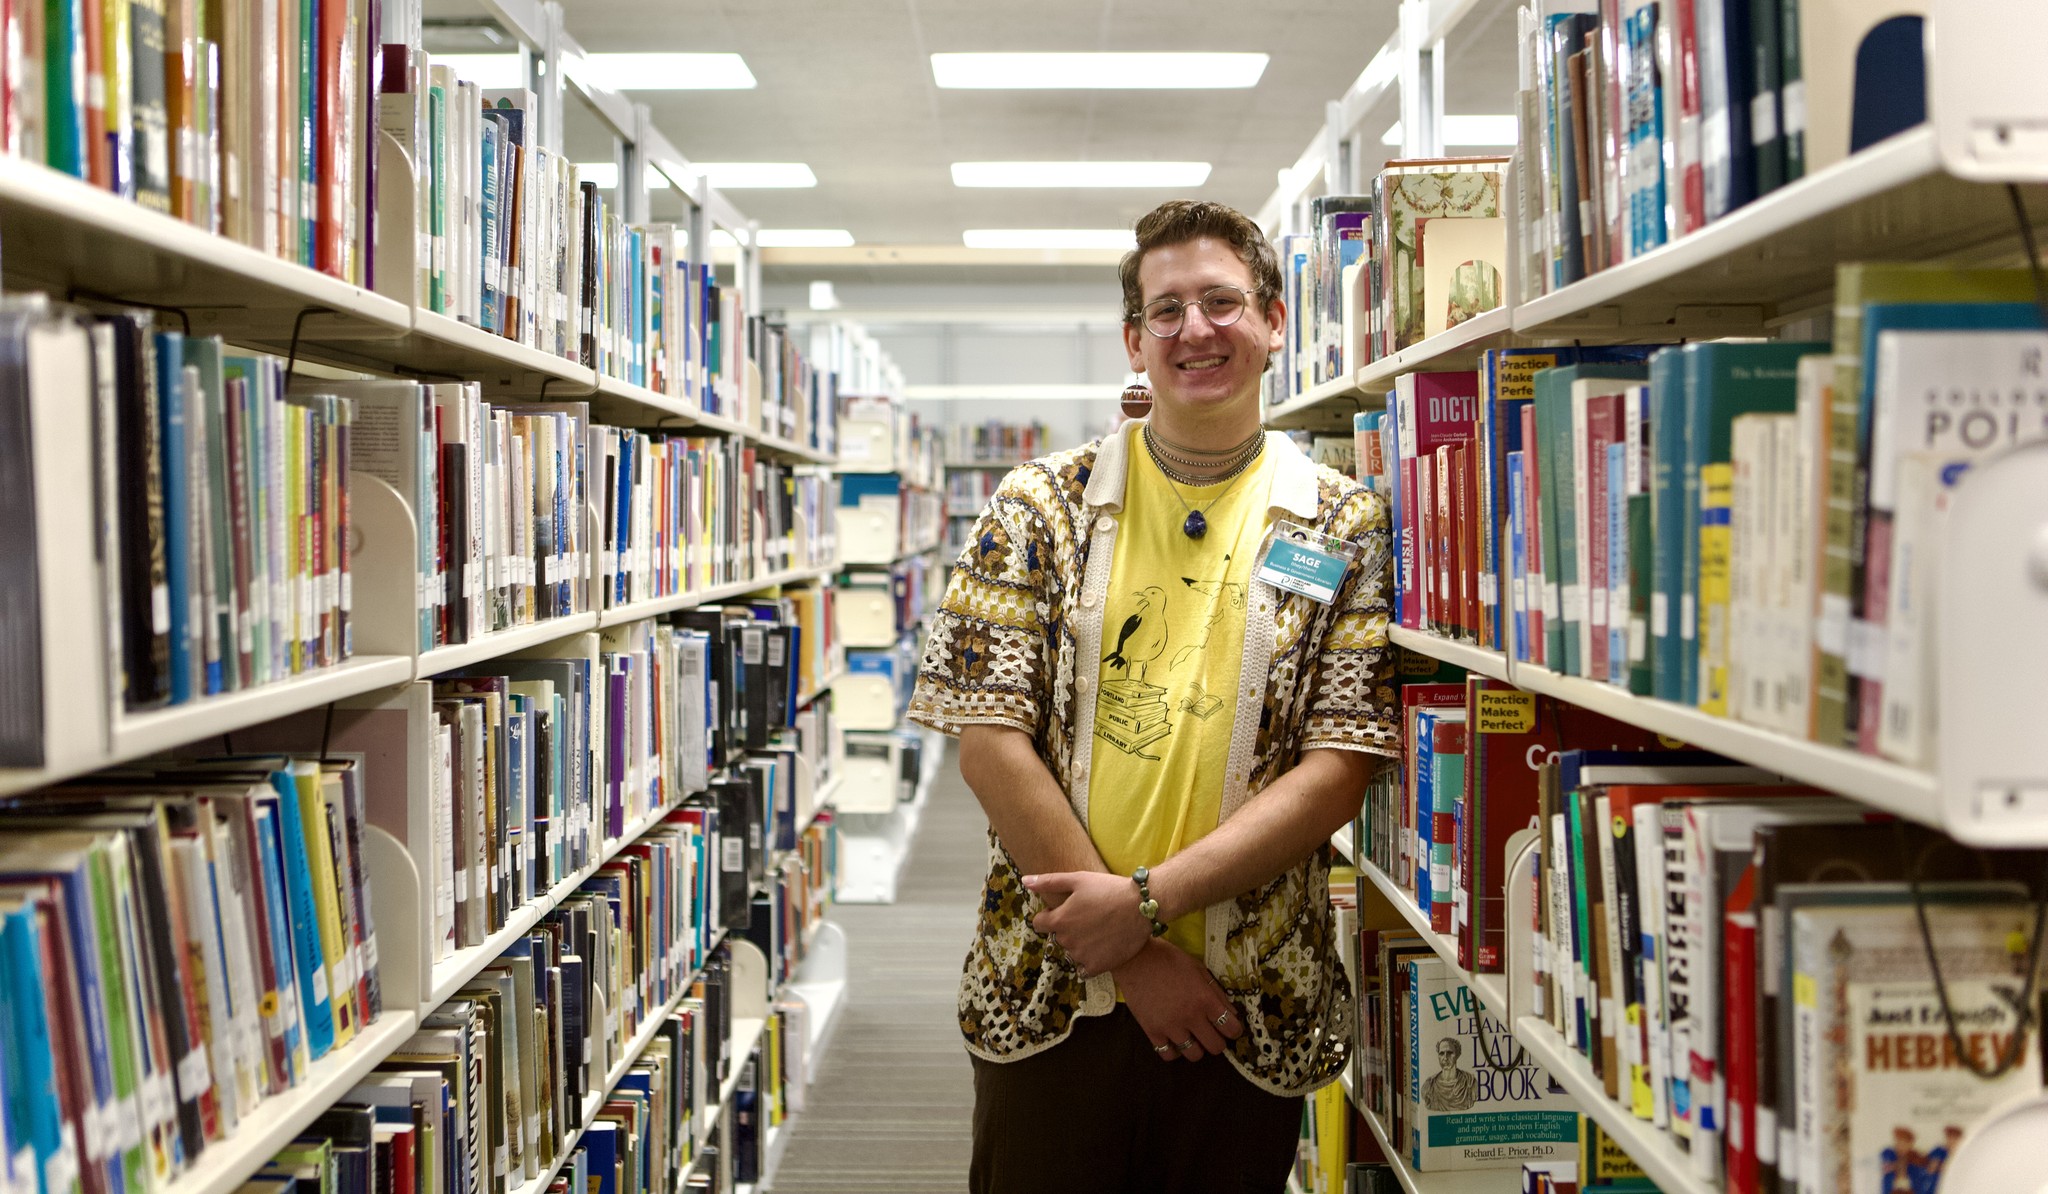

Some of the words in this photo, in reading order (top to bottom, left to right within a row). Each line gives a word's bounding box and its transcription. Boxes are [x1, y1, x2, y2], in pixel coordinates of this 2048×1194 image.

[1501, 359, 1549, 370] Practice
[1293, 553, 1321, 568] SAGE
[1101, 688, 1125, 704] PORTLAND
[1433, 692, 1459, 702] Expand
[1481, 694, 1529, 705] Practice
[1481, 707, 1520, 718] Makes
[1109, 713, 1129, 727] PUBLIC
[1481, 720, 1525, 730] Perfect
[1103, 731, 1128, 749] LIBRARY
[302, 891, 316, 972] PHENOMEN
[1410, 980, 1418, 1060] LEARNING
[1476, 1067, 1542, 1102] BOOK
[1446, 1116, 1463, 1125] Read
[1464, 1115, 1477, 1124] and
[1478, 1114, 1496, 1123] write
[1497, 1113, 1510, 1122] this
[1511, 1112, 1540, 1121] classical
[1541, 1112, 1573, 1122] language
[1457, 1125, 1470, 1133] and
[1471, 1124, 1489, 1134] apply
[1492, 1123, 1497, 1131] it
[1498, 1123, 1506, 1131] to
[1507, 1122, 1532, 1131] modern
[1534, 1121, 1561, 1131] English
[1455, 1135, 1487, 1144] grammar,
[1488, 1134, 1509, 1142] usage,
[1511, 1132, 1524, 1140] and
[1525, 1131, 1563, 1141] vocabulary
[1464, 1147, 1496, 1158] Richard
[1497, 1147, 1506, 1157] E.
[1508, 1146, 1530, 1156] Prior,
[1532, 1145, 1555, 1156] Ph.D.
